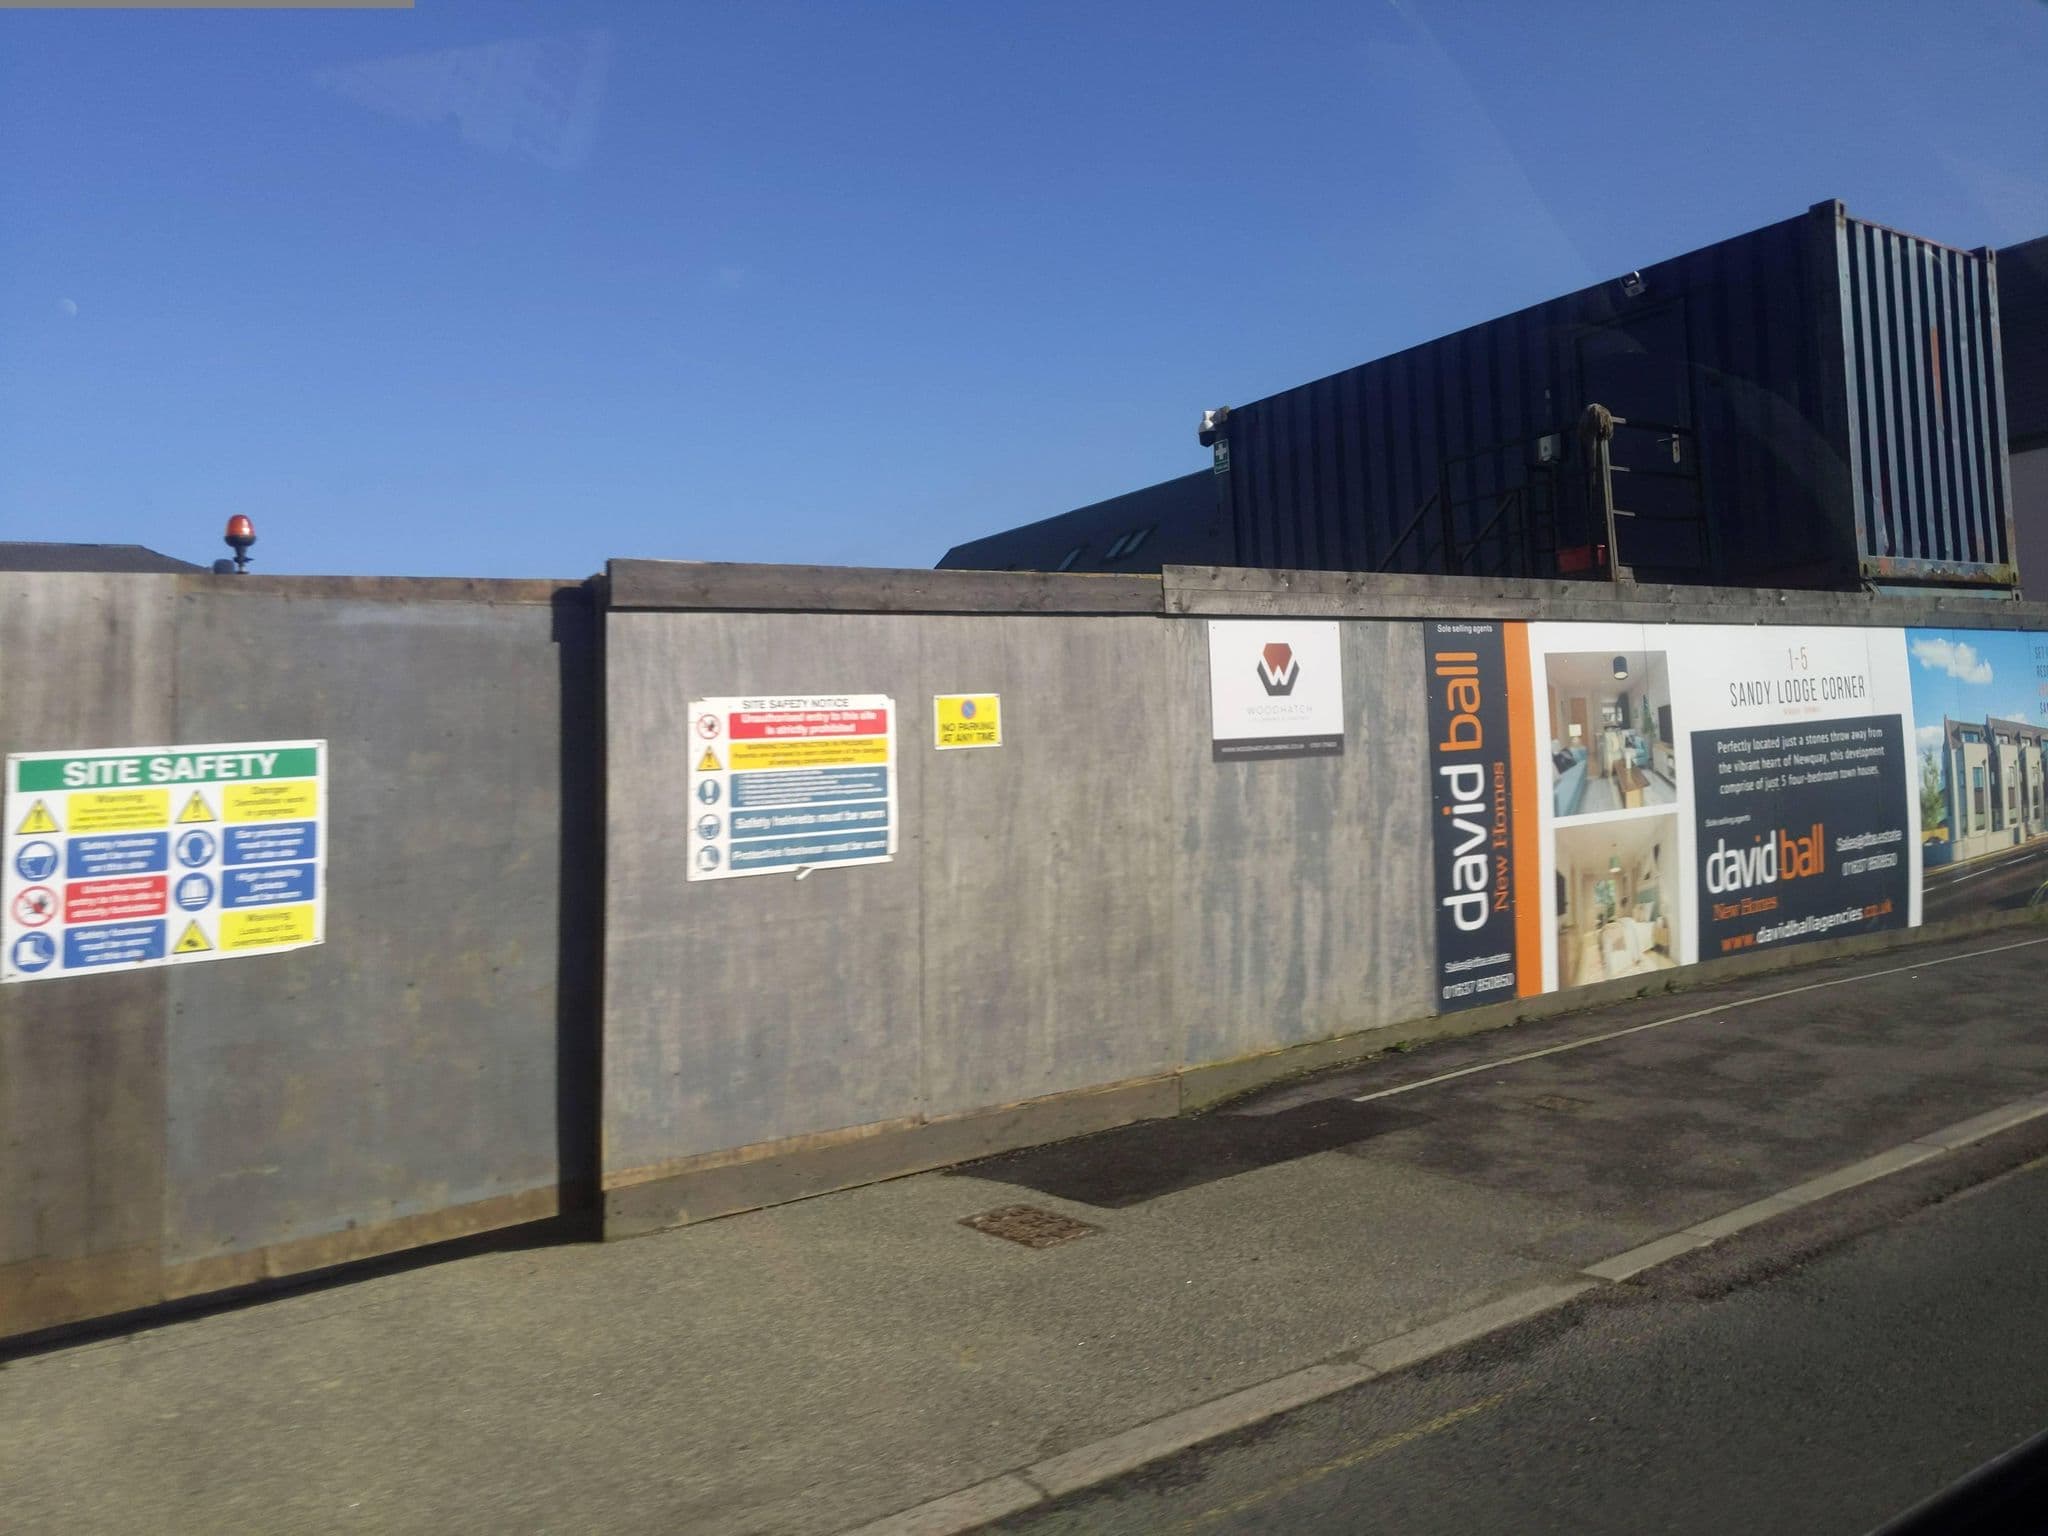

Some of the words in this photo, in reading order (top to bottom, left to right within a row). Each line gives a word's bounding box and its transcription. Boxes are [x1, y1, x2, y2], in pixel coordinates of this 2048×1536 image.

[1437, 624, 1452, 633] Sole
[1452, 624, 1473, 634] selling
[1473, 625, 1493, 634] agents
[1788, 647, 1808, 670] 1-5
[742, 700, 766, 710] SITE
[769, 699, 807, 709] SAFETY
[812, 698, 849, 707] NOTICE
[1435, 652, 1483, 752] ball
[1729, 681, 1771, 707] SANDY
[1777, 678, 1818, 704] LODGE
[1822, 675, 1866, 701] CORNER
[942, 723, 956, 732] NO
[958, 722, 995, 731] PARKING
[942, 734, 953, 743] AT
[957, 733, 973, 742] ANY
[976, 732, 995, 741] TIME
[1717, 738, 1752, 754] Perfectly
[1752, 736, 1780, 750] located
[1781, 735, 1797, 750] just
[1805, 734, 1829, 745] stones
[1830, 730, 1850, 742] throw
[1851, 729, 1867, 742] away
[1867, 727, 1883, 738] from
[62, 759, 142, 788] SITE
[148, 752, 280, 783] SAFETY
[1719, 761, 1732, 774] the
[1733, 760, 1760, 773] vibrant
[1761, 757, 1782, 769] heart
[1783, 754, 1792, 767] of
[1830, 749, 1844, 761] this
[1845, 746, 1885, 759] development
[1720, 779, 1755, 796] comprise
[1755, 777, 1764, 790] of
[1764, 776, 1780, 792] just
[1781, 774, 1787, 787] 5
[1492, 762, 1508, 848] Homes
[1440, 763, 1490, 931] david
[1706, 829, 1777, 894] david
[1780, 823, 1825, 880] ball
[1495, 855, 1509, 912] New
[1712, 903, 1740, 921] New
[1741, 897, 1778, 915] Homes
